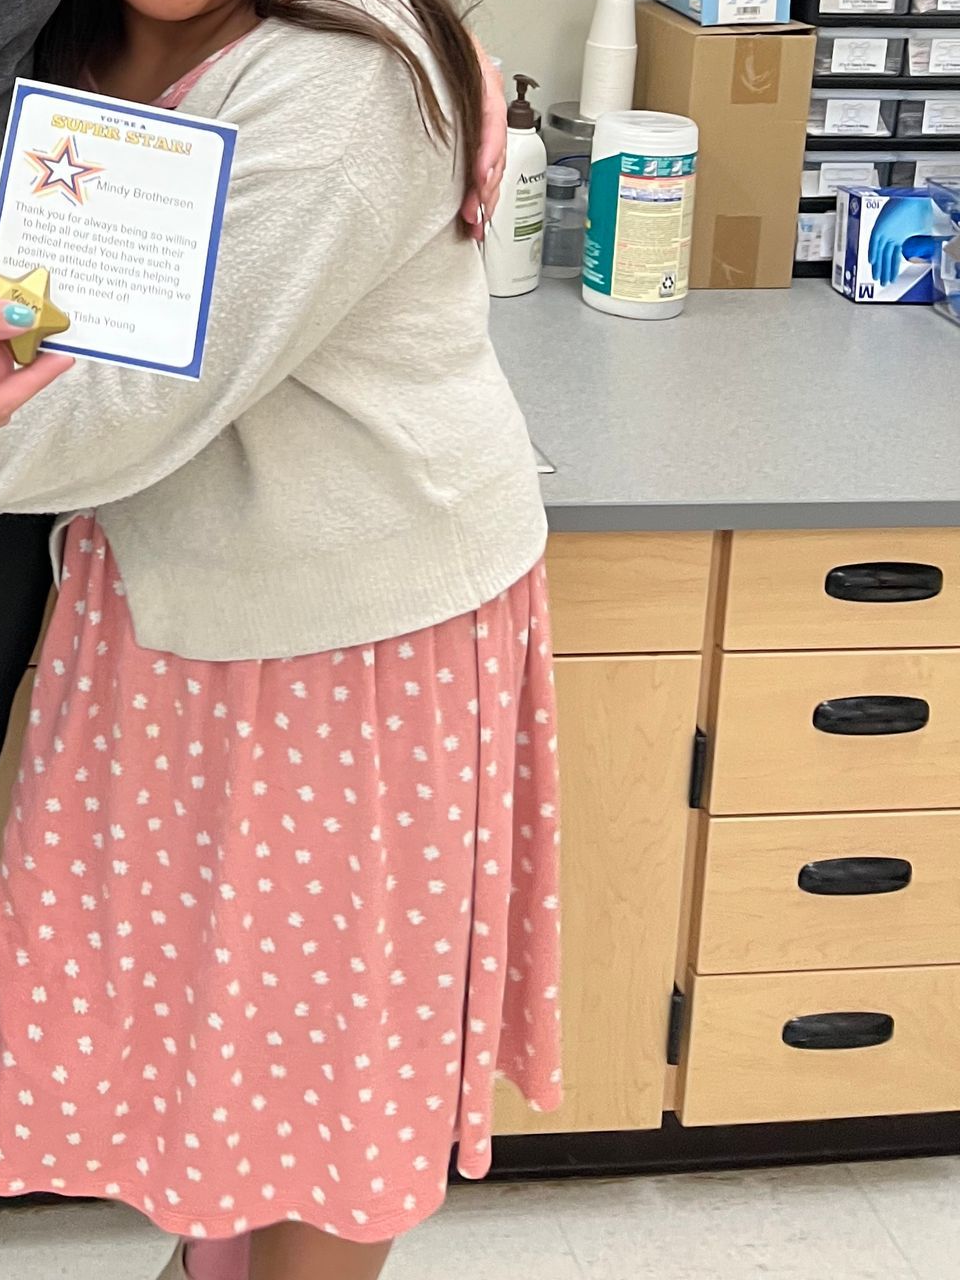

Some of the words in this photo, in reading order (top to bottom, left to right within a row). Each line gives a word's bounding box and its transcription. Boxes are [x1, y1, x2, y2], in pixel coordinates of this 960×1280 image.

[50, 113, 121, 141] SUPER
[124, 129, 193, 156] STAR!
[100, 114, 137, 129] YOU'RE
[96, 179, 131, 198] Mindy
[15, 200, 45, 216] Thank
[46, 210, 66, 221] you
[67, 213, 81, 224] for
[83, 216, 118, 234] always
[120, 223, 148, 240] being
[150, 232, 163, 241] so
[165, 233, 198, 249] willing
[23, 218, 33, 228] to
[35, 221, 57, 234] help
[58, 224, 71, 236] all
[73, 230, 90, 240] our
[91, 232, 136, 249] students
[137, 240, 160, 254] with
[161, 245, 185, 259] their
[17, 244, 57, 262] positive
[58, 253, 98, 270] attitude
[100, 261, 141, 278] towards
[142, 269, 180, 287] helping
[22, 231, 62, 248] medical
[63, 241, 97, 256] needs!
[100, 247, 119, 260] You
[120, 251, 145, 265] have
[146, 257, 172, 270] such
[174, 264, 180, 272] a
[48, 265, 68, 278] and
[70, 270, 104, 287] faculty
[106, 276, 128, 289] with
[130, 282, 174, 300] anything
[176, 292, 191, 301] we
[58, 283, 74, 293] are
[76, 284, 87, 294] in
[88, 288, 114, 301] need
[859, 285, 874, 299] M
[73, 310, 101, 325] Tisha
[104, 318, 137, 333] Young
